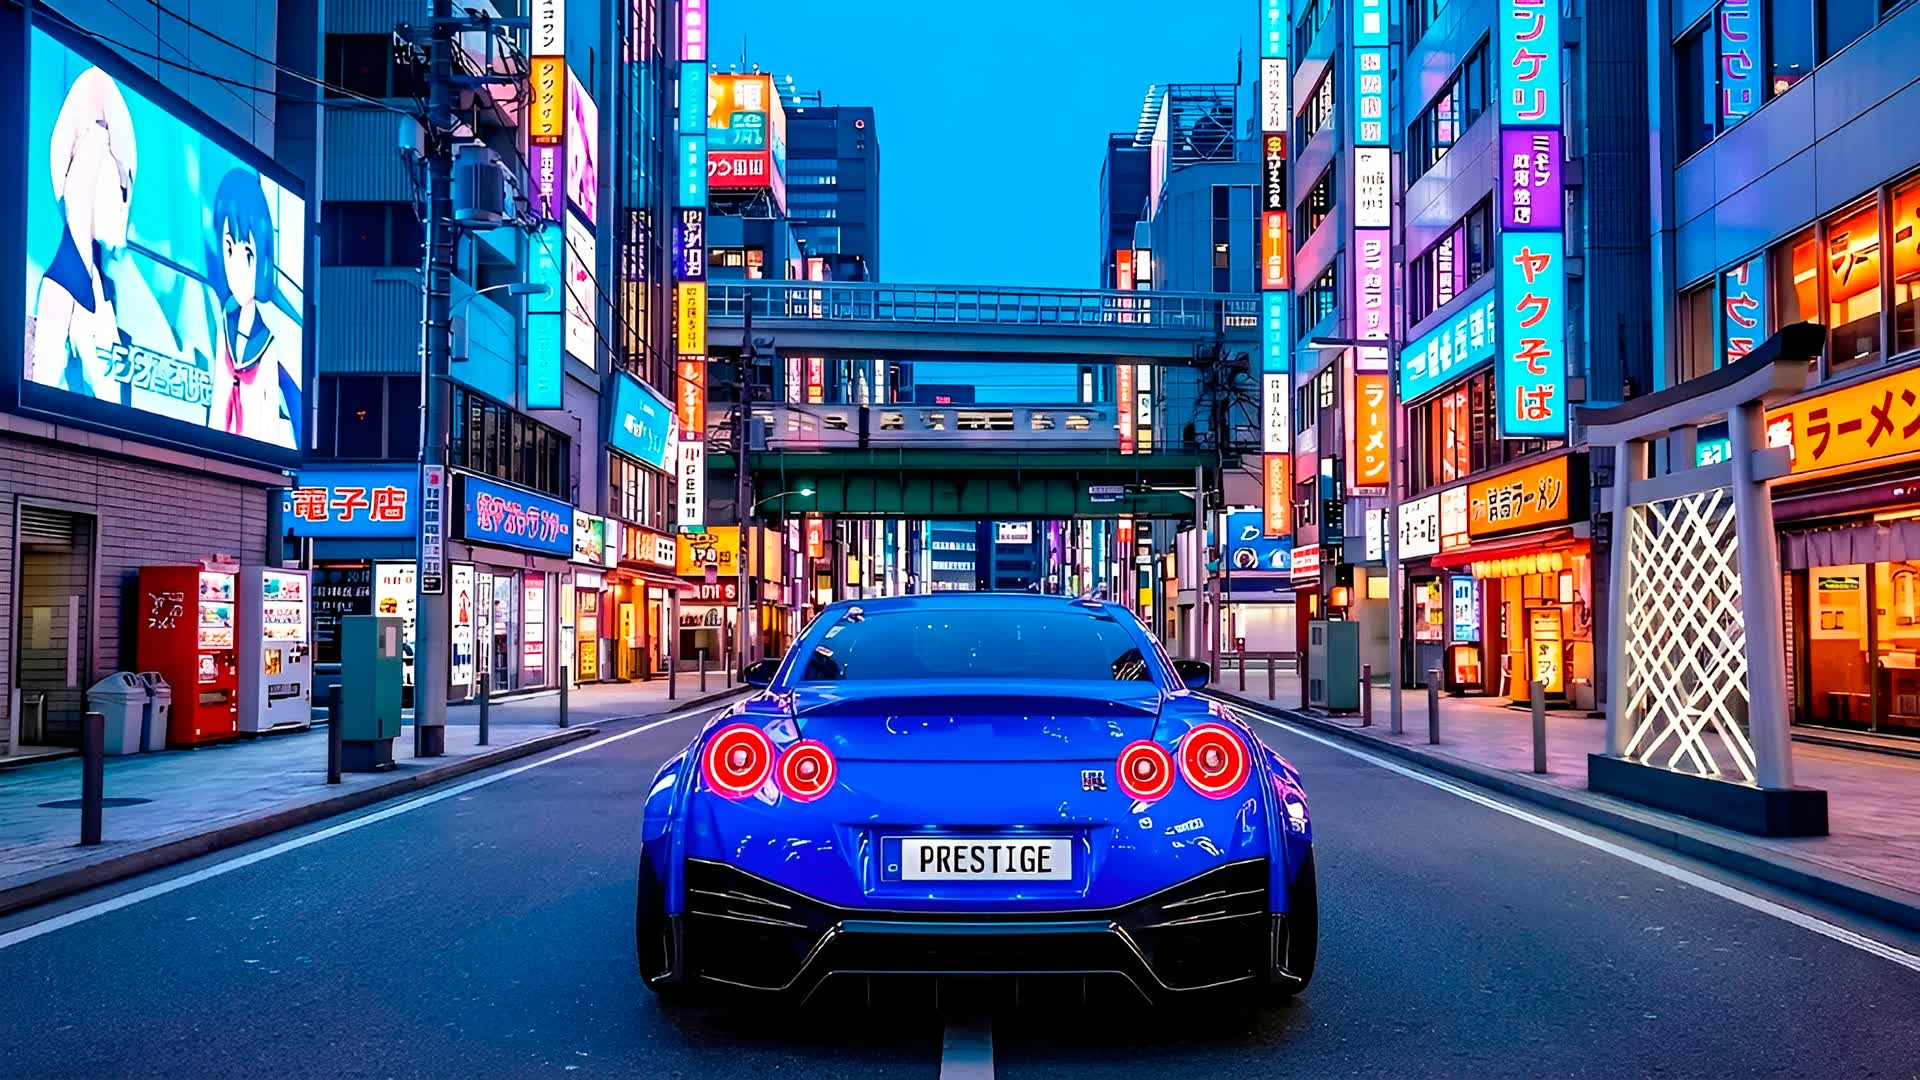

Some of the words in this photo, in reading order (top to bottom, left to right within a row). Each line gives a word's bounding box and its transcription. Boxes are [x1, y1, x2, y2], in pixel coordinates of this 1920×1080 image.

[1512, 0, 1548, 120] ンケリ
[1513, 246, 1554, 421] ヤクそば
[1364, 383, 1386, 477] ラーメン
[1807, 388, 1920, 461] ラーメン
[919, 845, 1052, 873] PRESTIGE
